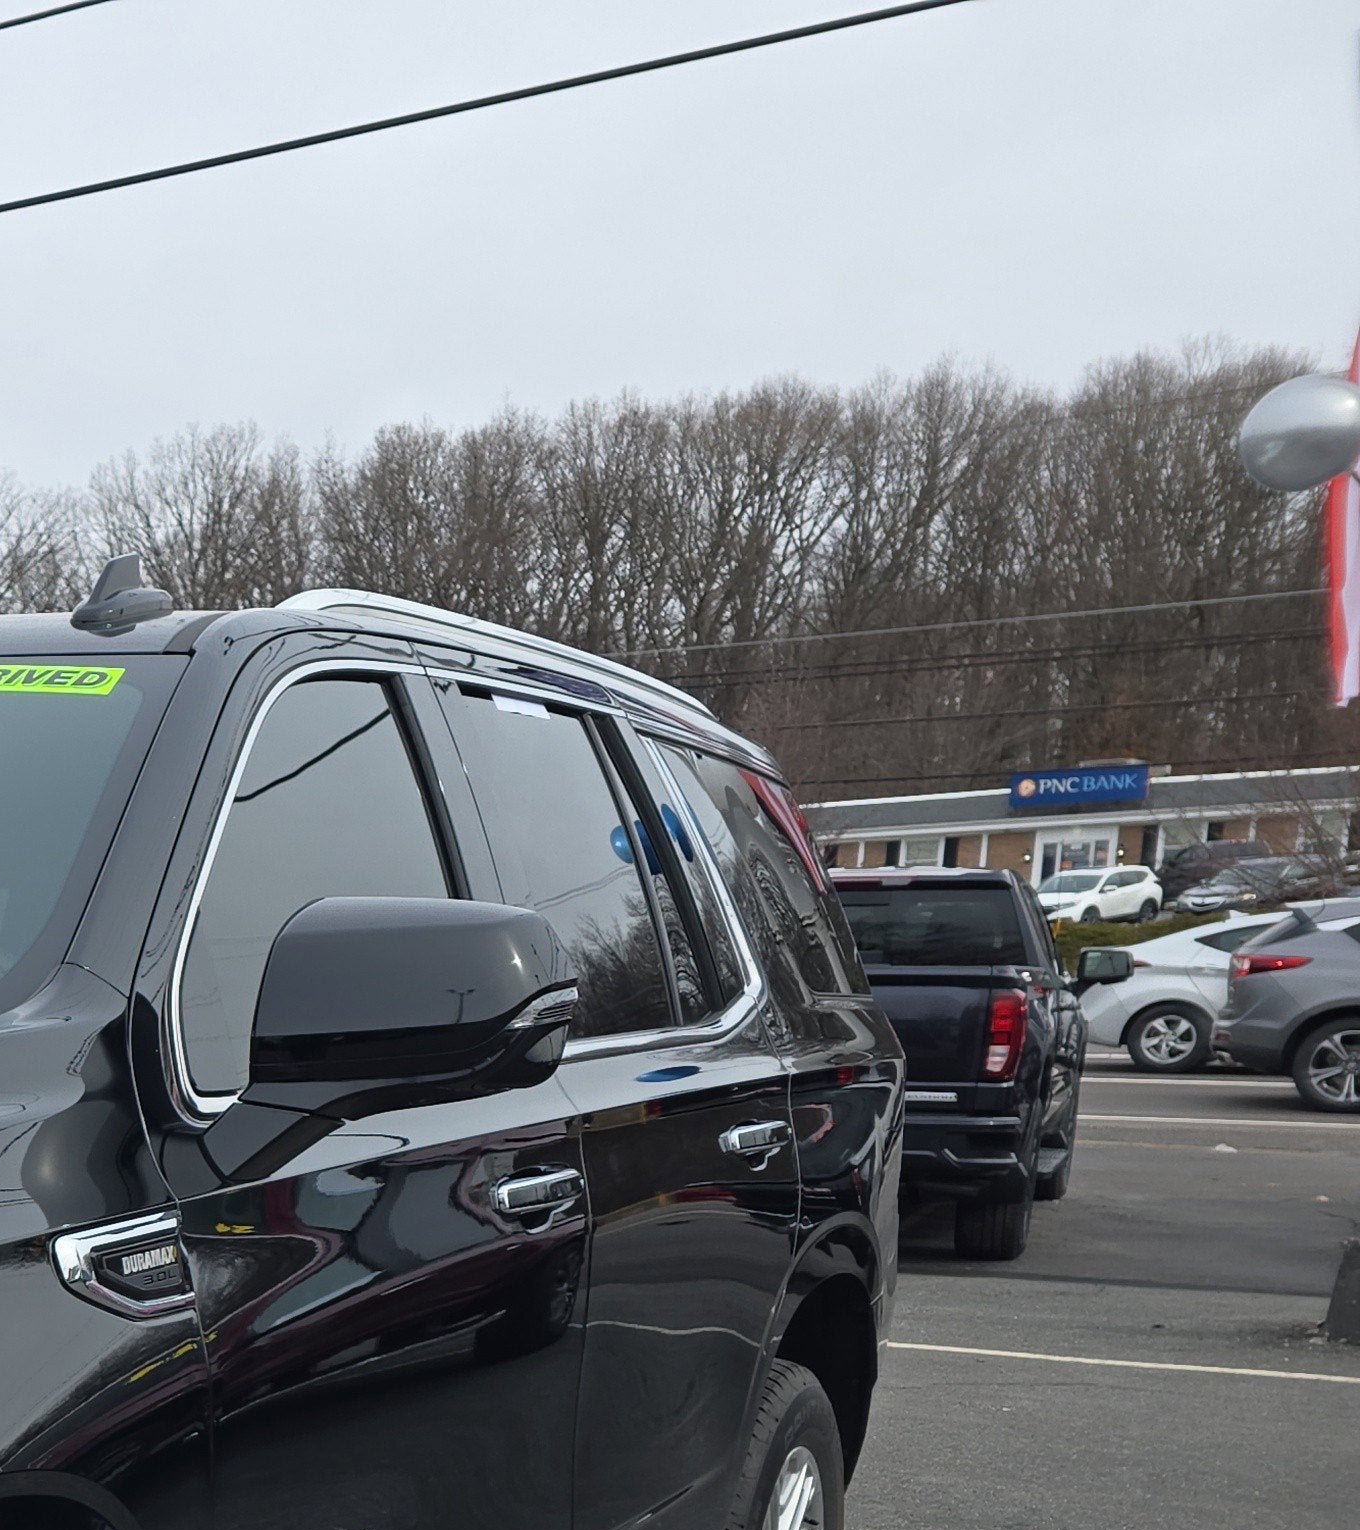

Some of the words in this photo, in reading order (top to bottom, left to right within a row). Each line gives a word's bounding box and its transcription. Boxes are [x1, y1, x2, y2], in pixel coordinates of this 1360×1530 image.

[1039, 776, 1079, 794] PNC
[1082, 773, 1138, 793] BANK
[122, 1245, 177, 1276] DURAMAX
